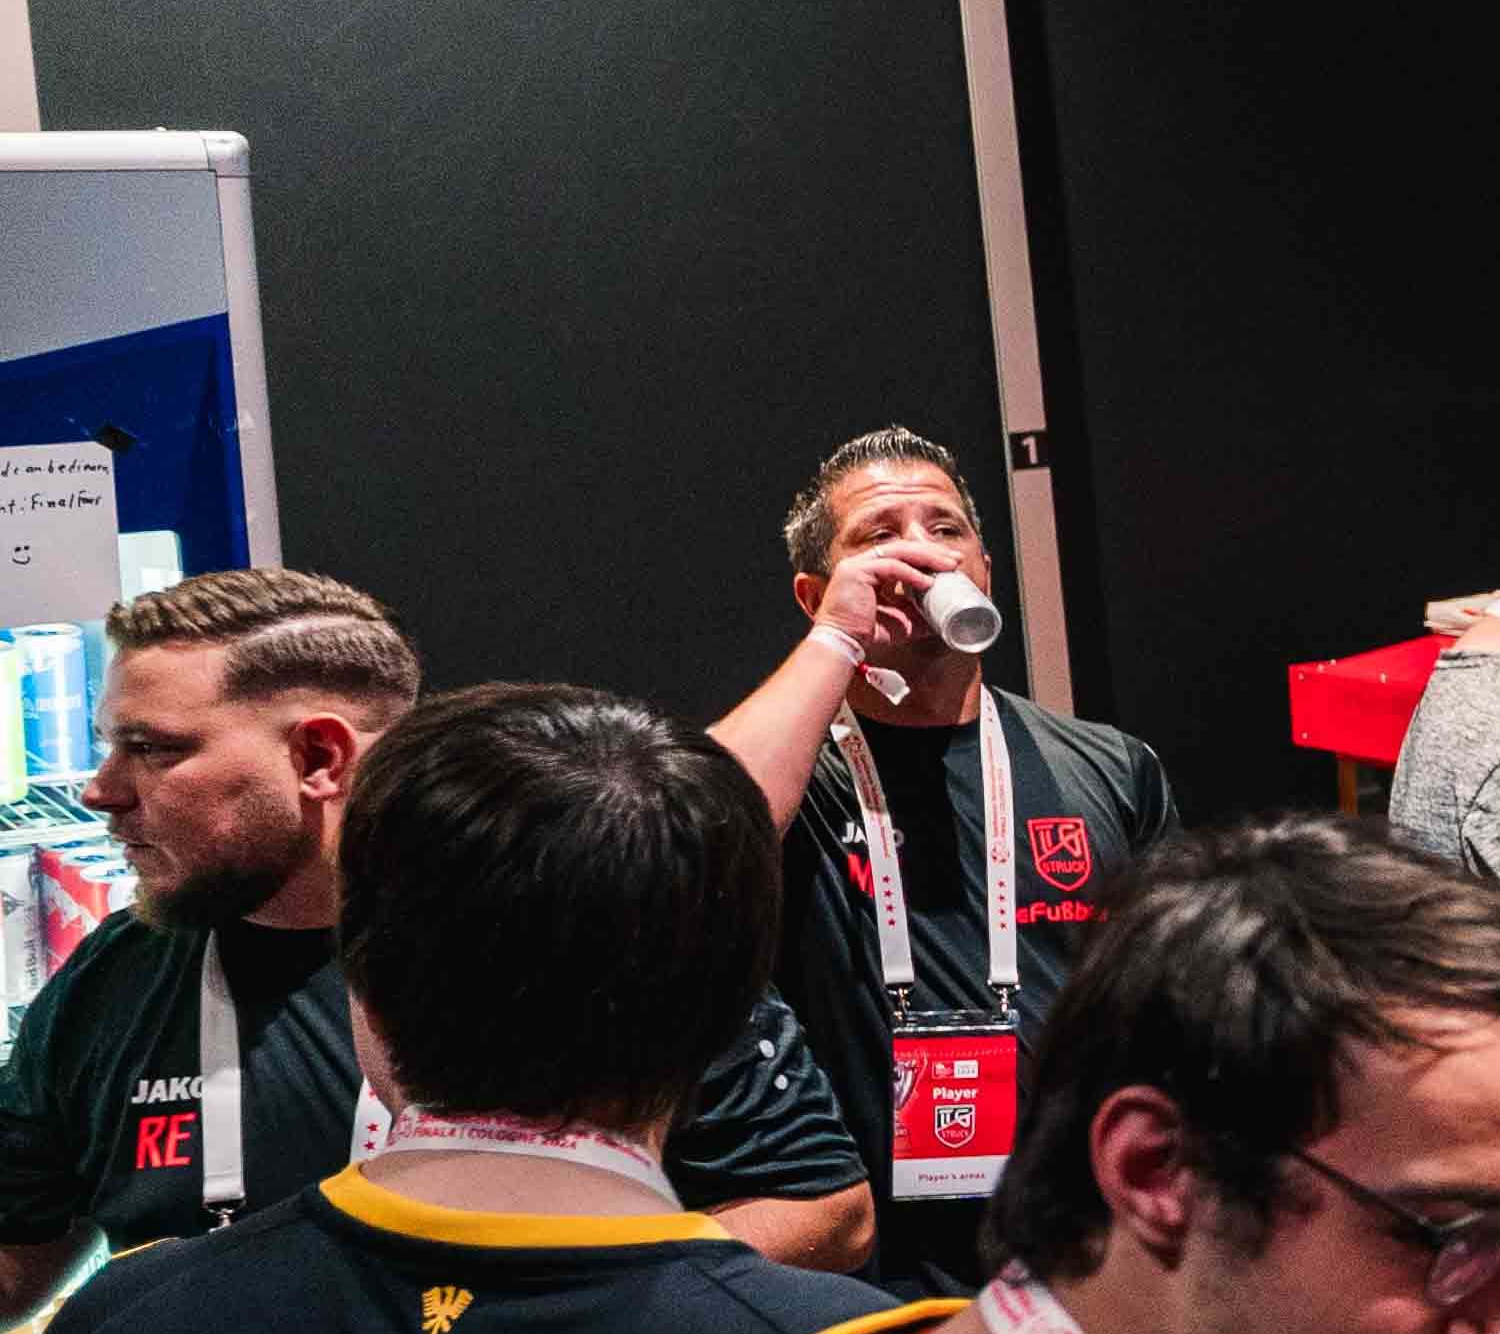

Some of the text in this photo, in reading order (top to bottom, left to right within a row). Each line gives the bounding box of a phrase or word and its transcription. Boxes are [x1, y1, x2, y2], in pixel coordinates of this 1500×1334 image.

[842, 821, 905, 848] JAO
[932, 1087, 977, 1101] Player
[136, 1113, 196, 1169] RE
